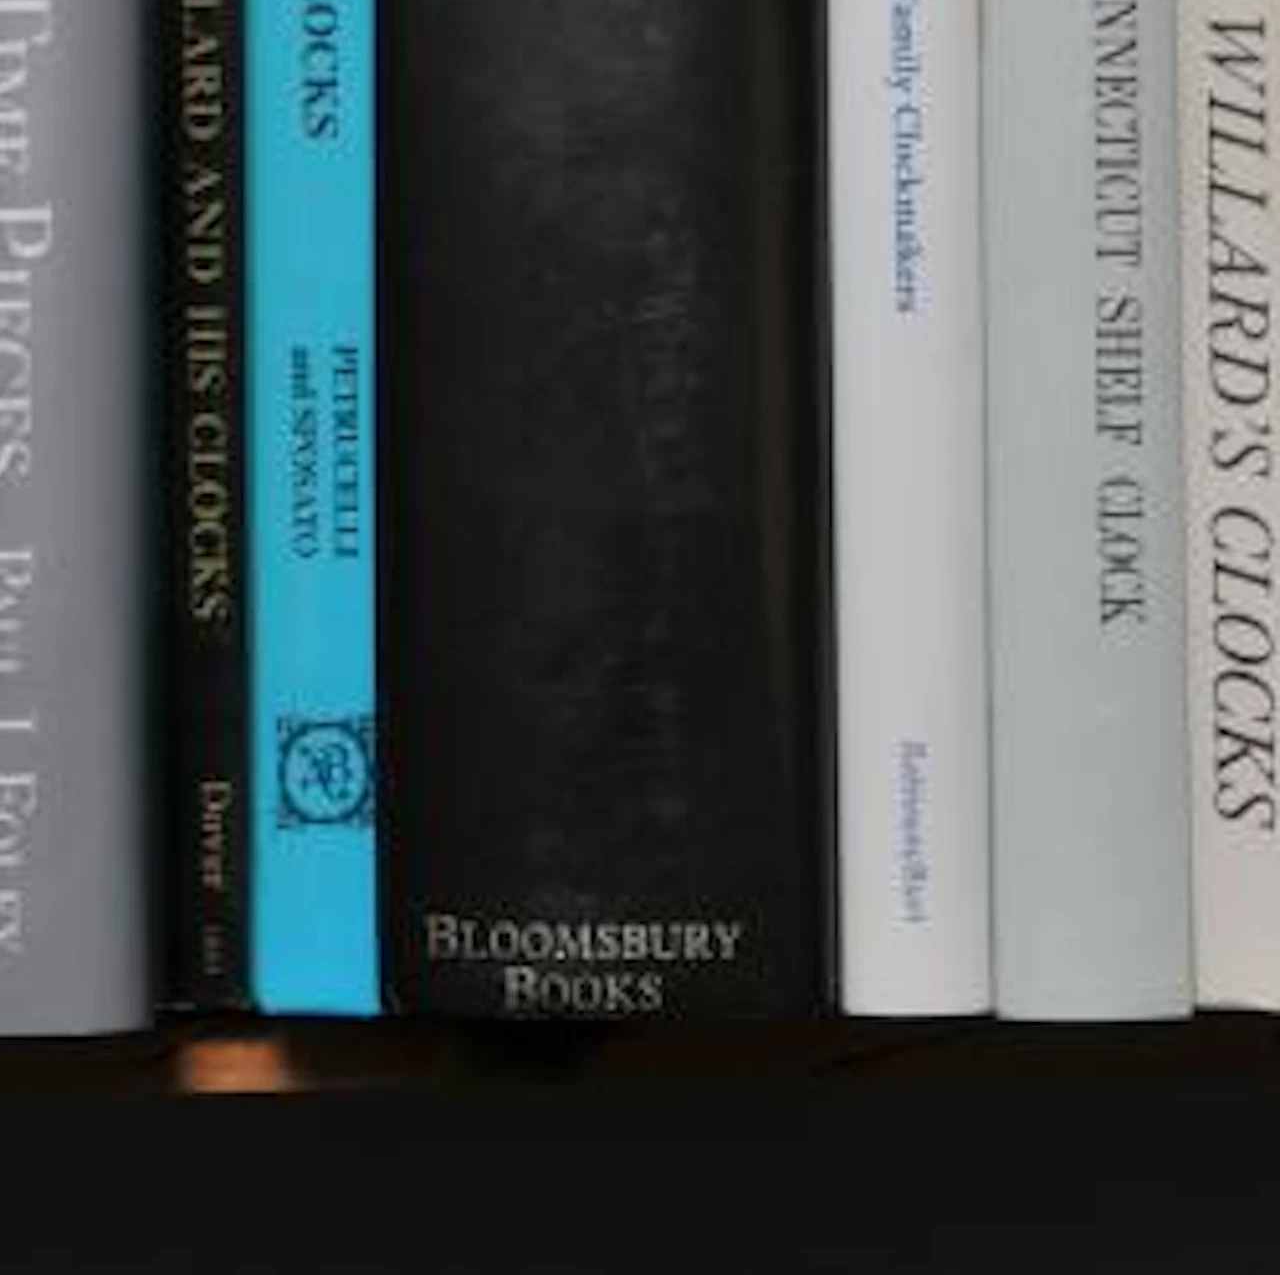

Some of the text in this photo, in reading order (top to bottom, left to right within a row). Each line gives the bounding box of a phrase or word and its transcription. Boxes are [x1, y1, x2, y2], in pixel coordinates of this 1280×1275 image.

[183, 161, 224, 284] AND
[892, 103, 924, 315] Clockmakers
[1207, 16, 1272, 481] WILLARD'S
[185, 303, 227, 393] HIS
[291, 344, 318, 399] and
[1096, 295, 1143, 446] SHELF
[185, 412, 229, 622] CLOCKS
[1098, 475, 1146, 626] CLOCK
[1210, 505, 1277, 832] CLOCKS
[426, 915, 742, 962] BLOOMSBURY
[503, 965, 664, 1014] BOOKS
